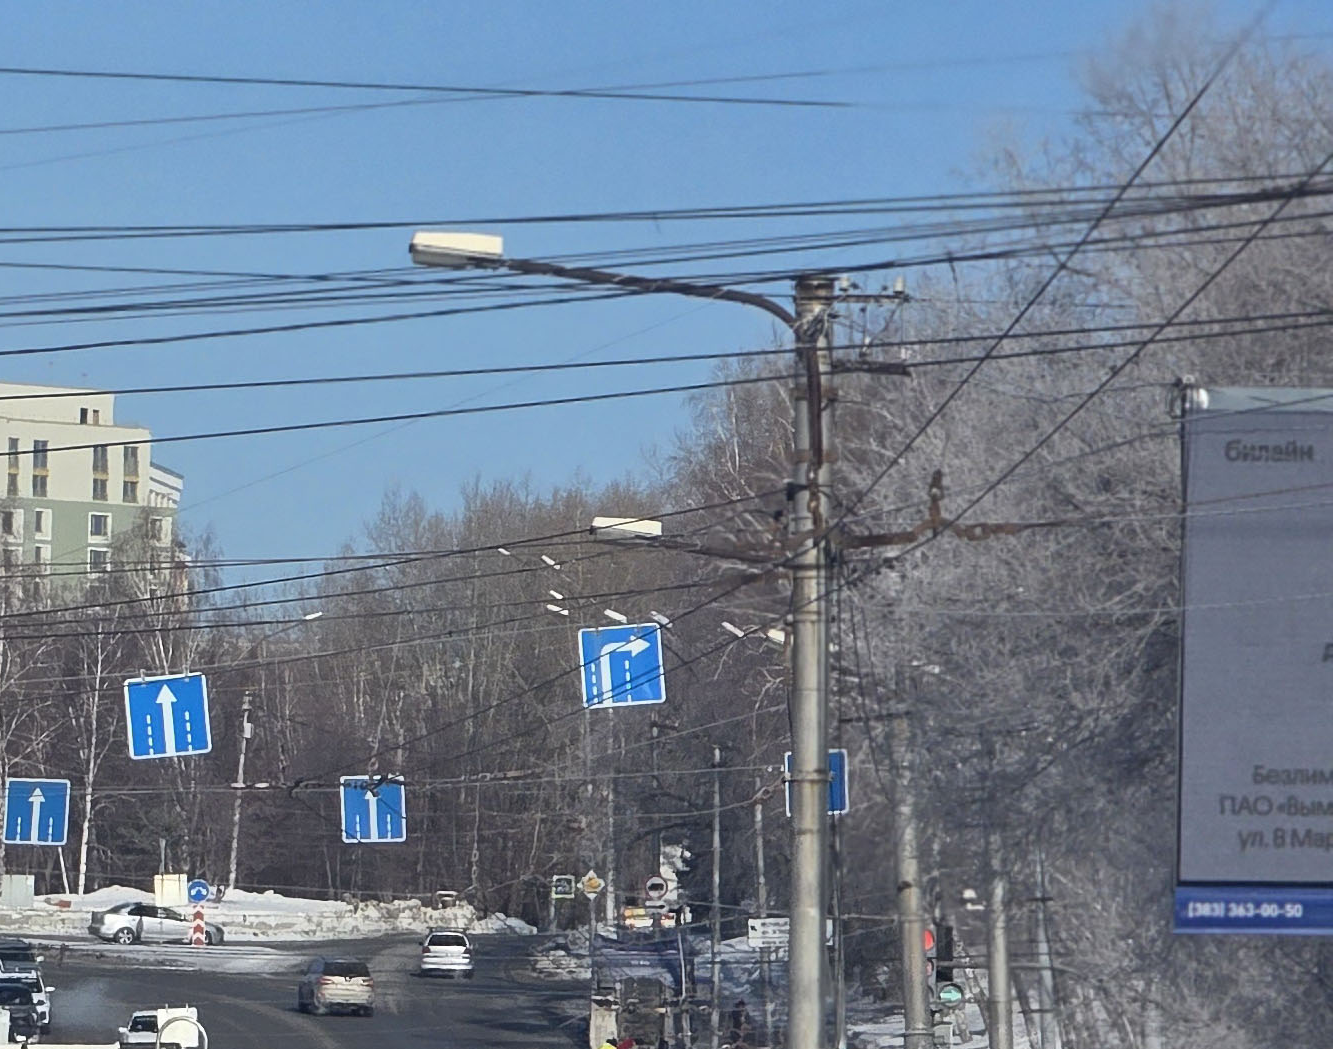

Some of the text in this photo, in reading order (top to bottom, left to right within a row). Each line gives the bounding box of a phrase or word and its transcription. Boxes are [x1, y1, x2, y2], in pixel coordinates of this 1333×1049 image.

[1224, 439, 1314, 462] билайн
[1219, 795, 1273, 816] ПАО
[1237, 829, 1270, 852] ул.
[1228, 902, 1303, 918] 363-00-50
